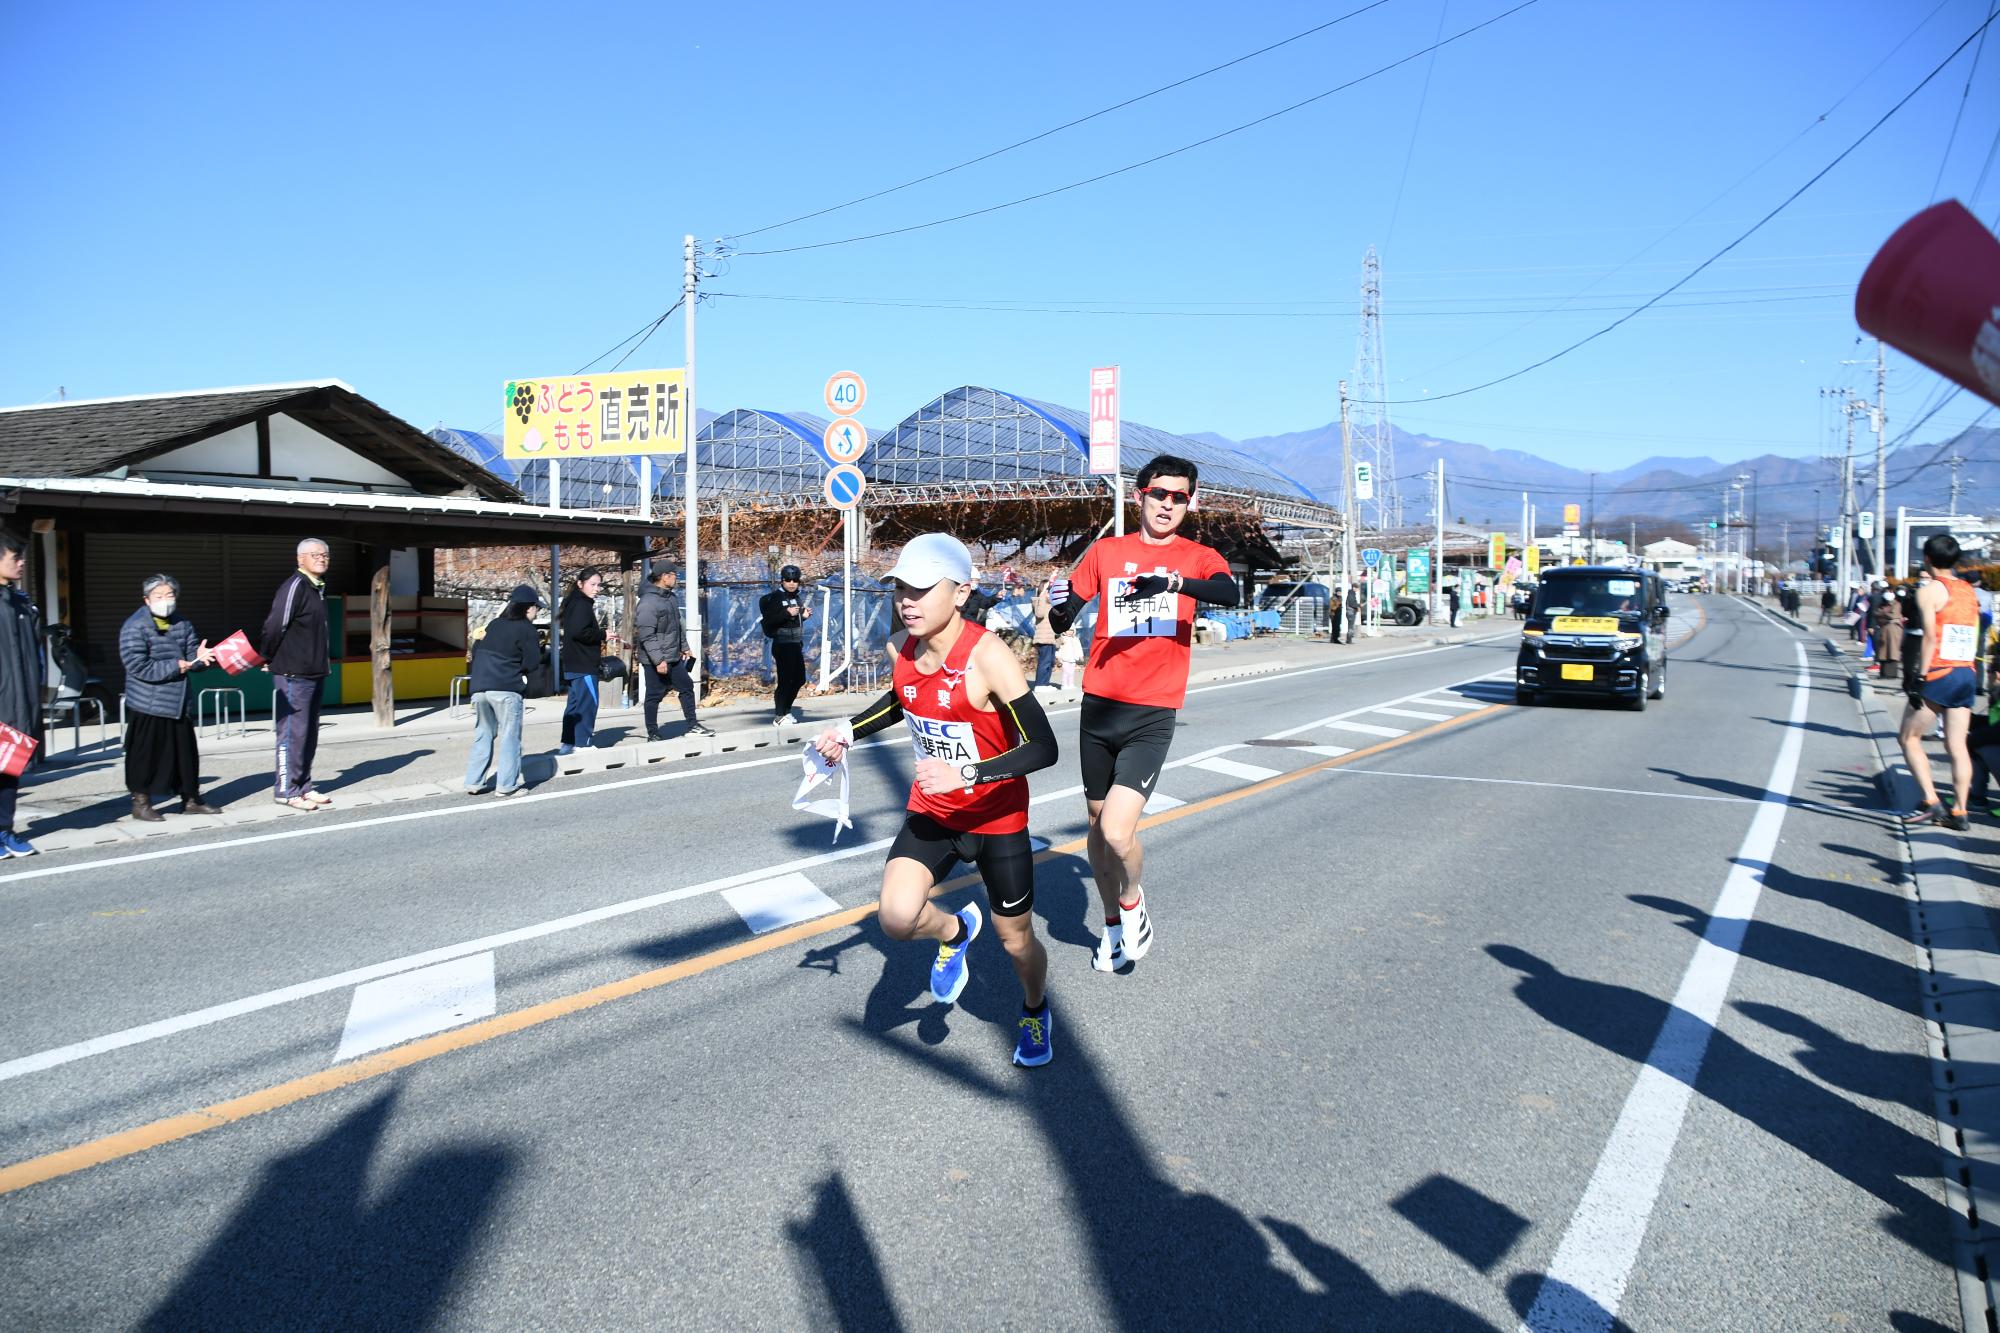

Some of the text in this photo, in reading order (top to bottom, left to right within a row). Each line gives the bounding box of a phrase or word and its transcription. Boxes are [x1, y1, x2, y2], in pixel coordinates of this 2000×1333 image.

[537, 381, 594, 414] ぶどう
[835, 384, 856, 403] 40
[600, 383, 679, 442] 直売所
[554, 420, 594, 451] もも
[1410, 559, 1422, 572] P
[1131, 615, 1153, 634] 11
[903, 685, 917, 703] 甲
[907, 713, 961, 740] NEC
